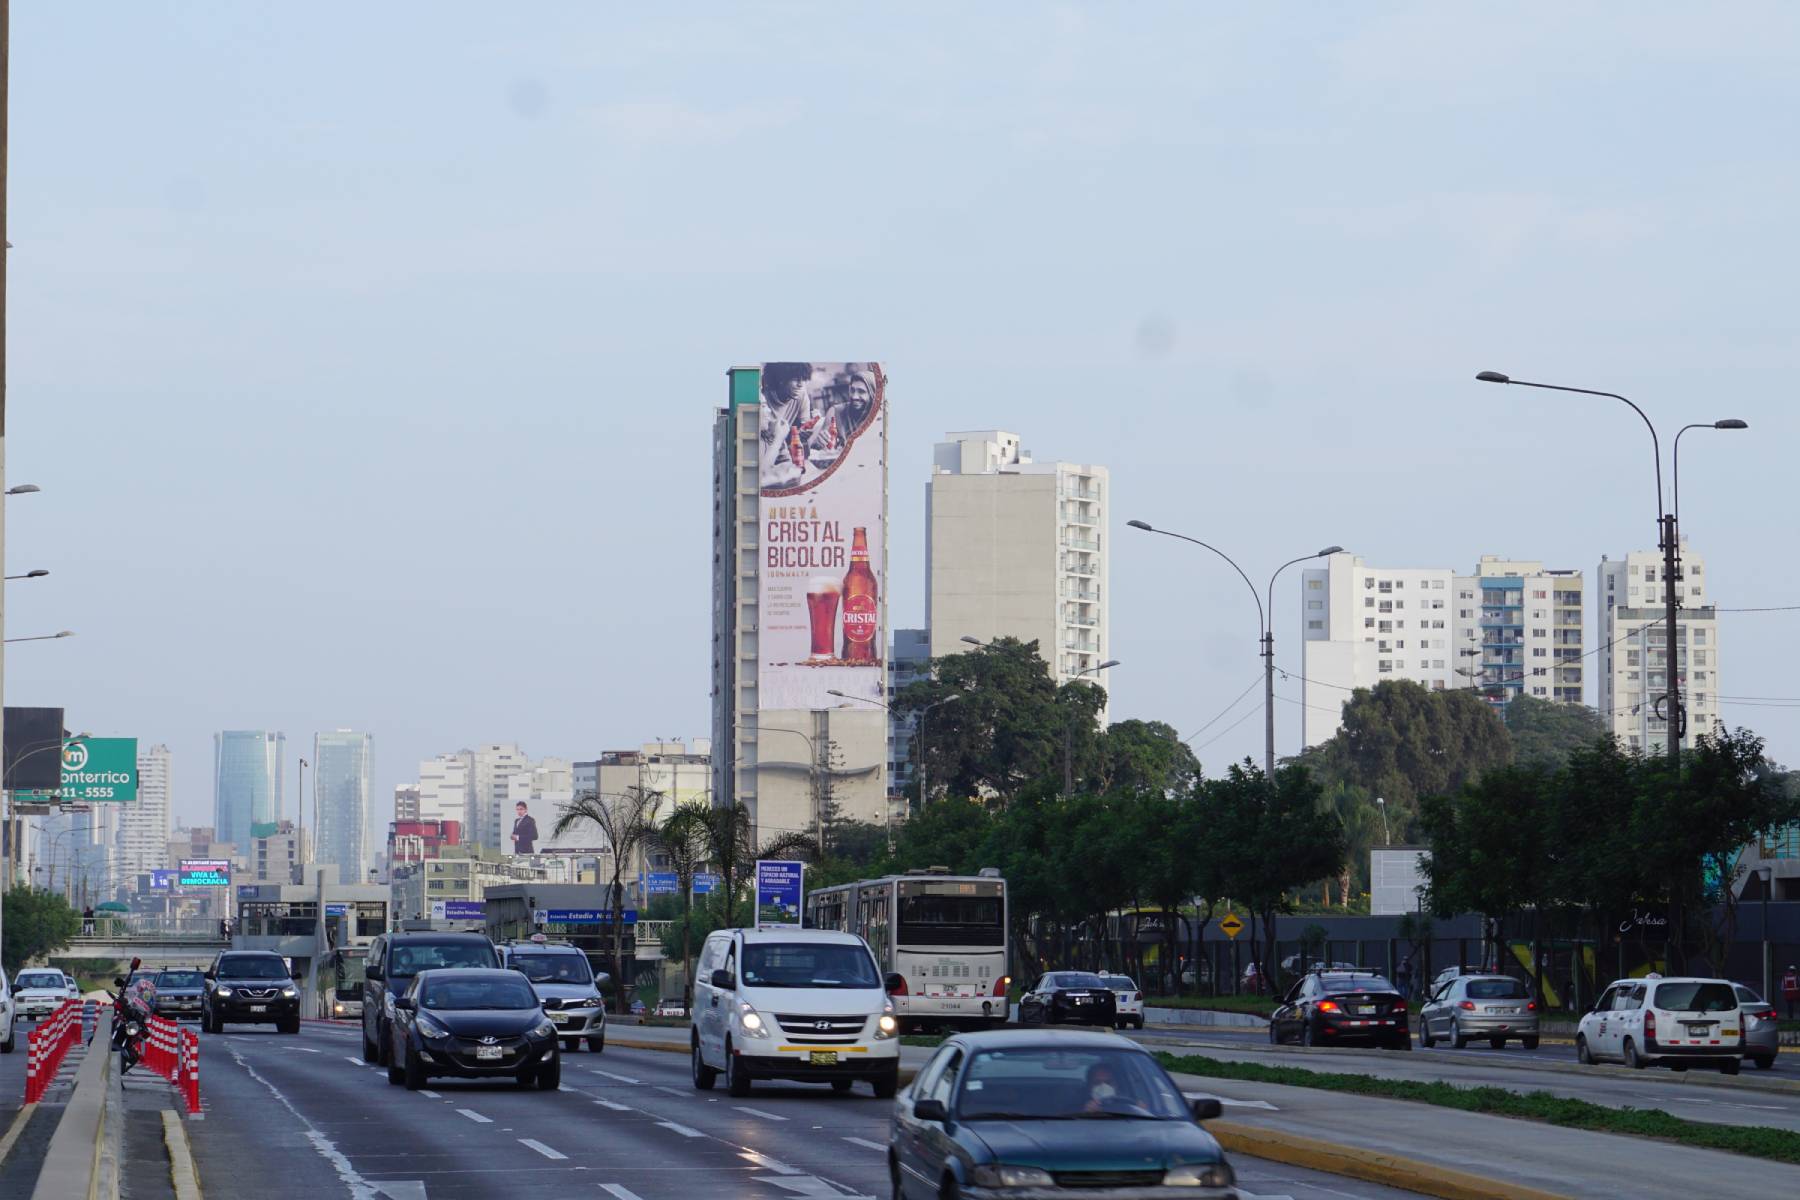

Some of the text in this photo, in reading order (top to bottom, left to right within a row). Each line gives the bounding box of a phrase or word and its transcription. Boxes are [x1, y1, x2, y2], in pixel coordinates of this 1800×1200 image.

[768, 507, 818, 520] NUEVA
[767, 521, 845, 542] CRISTAL
[767, 546, 845, 567] BICOLOR
[843, 611, 877, 624] CRISTAL
[61, 771, 130, 784] onterrico
[568, 912, 593, 920] Estadio
